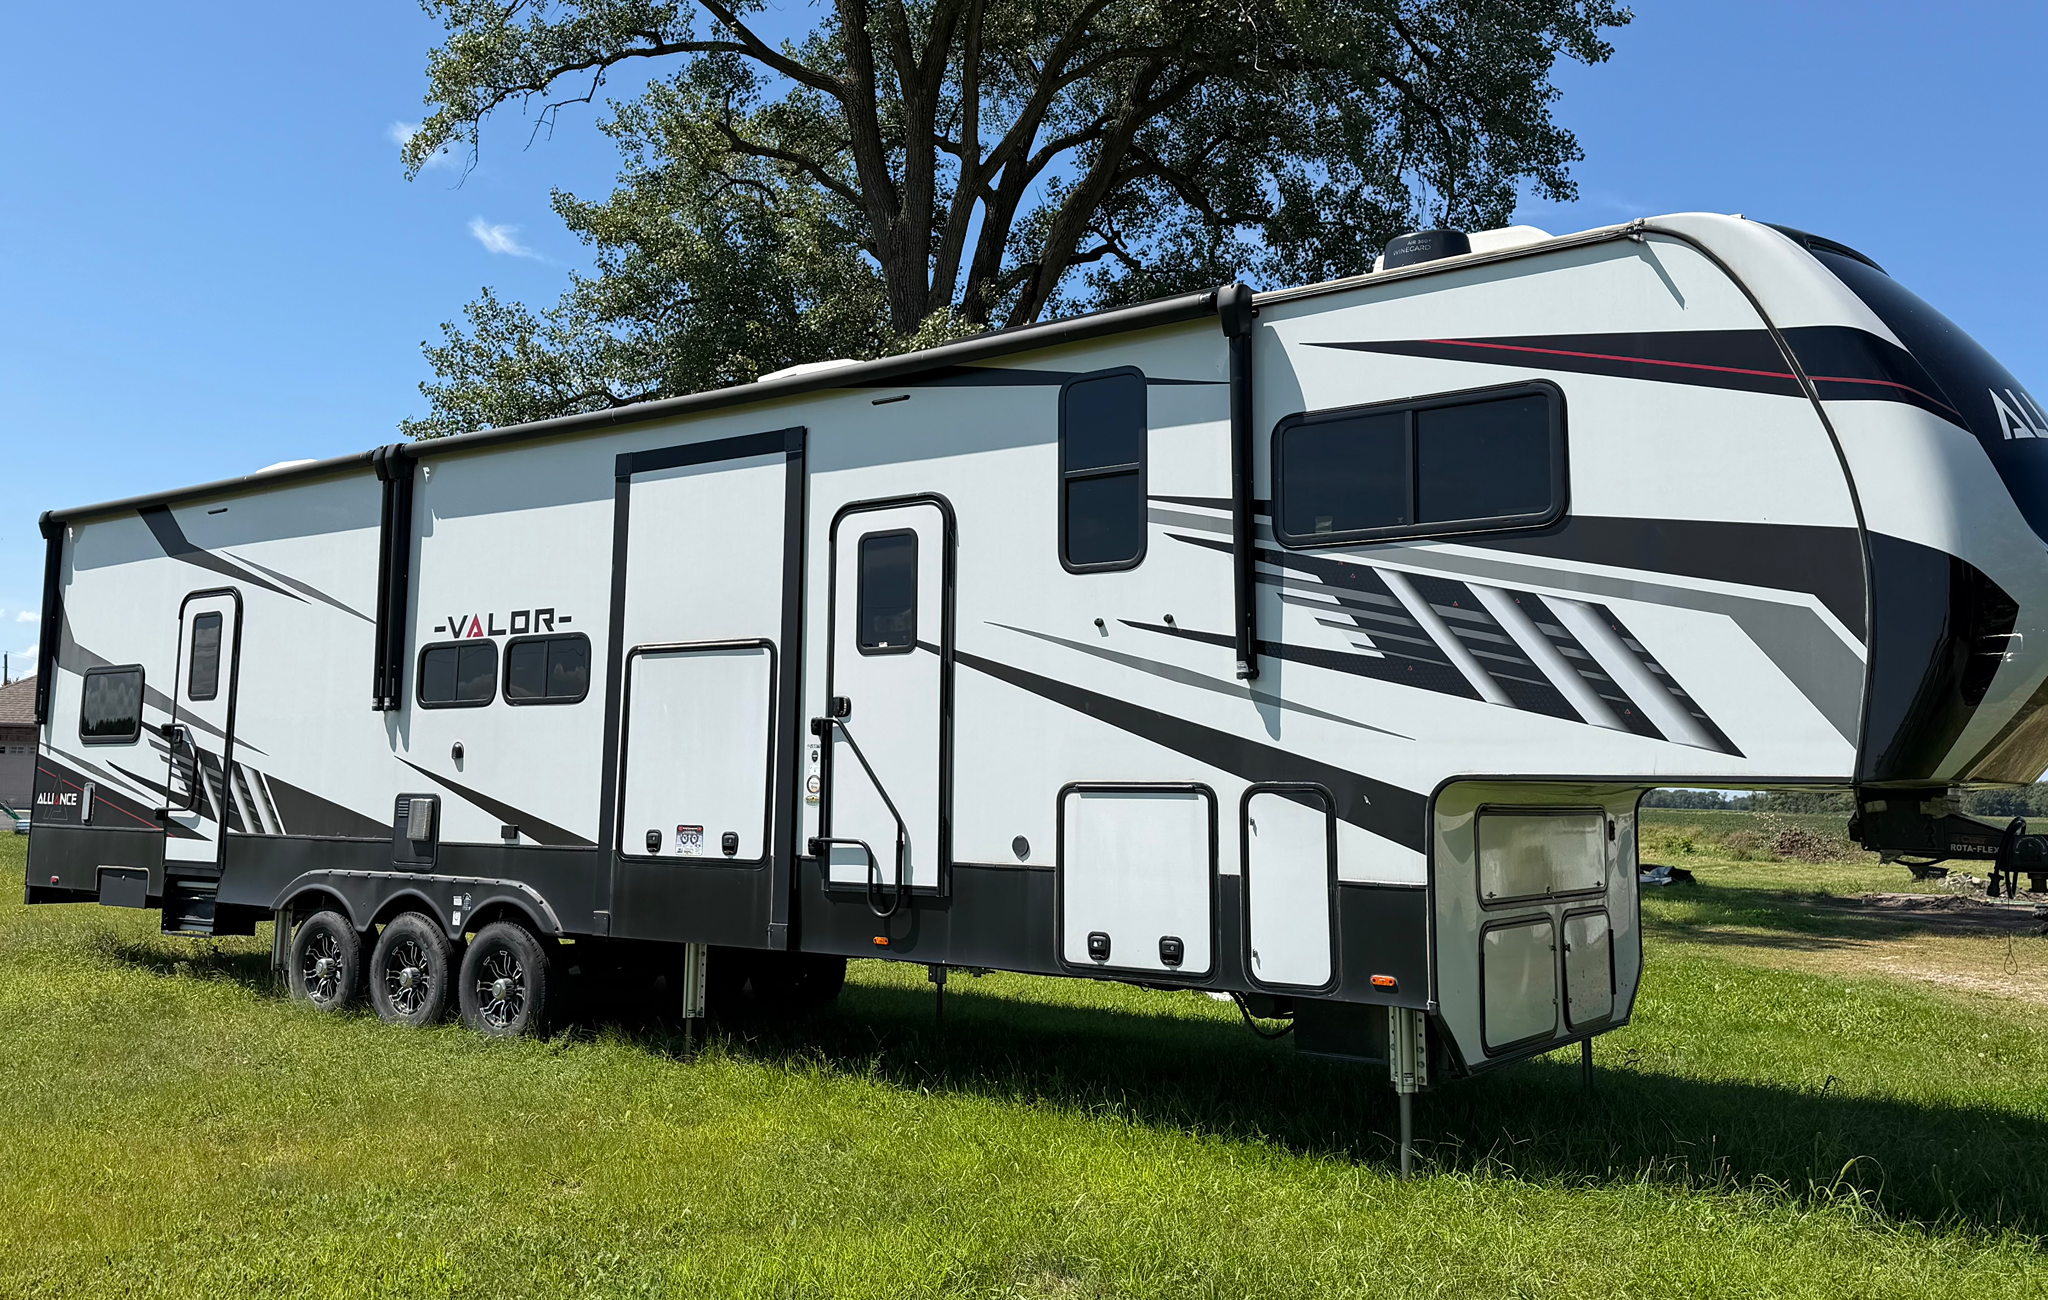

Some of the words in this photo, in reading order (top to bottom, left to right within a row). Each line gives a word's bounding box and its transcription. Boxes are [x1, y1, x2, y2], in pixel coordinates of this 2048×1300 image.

[1393, 244, 1432, 256] WINEGARD
[36, 792, 78, 806] ALLIANCE
[1950, 843, 2000, 854] ROTA-FLEX
